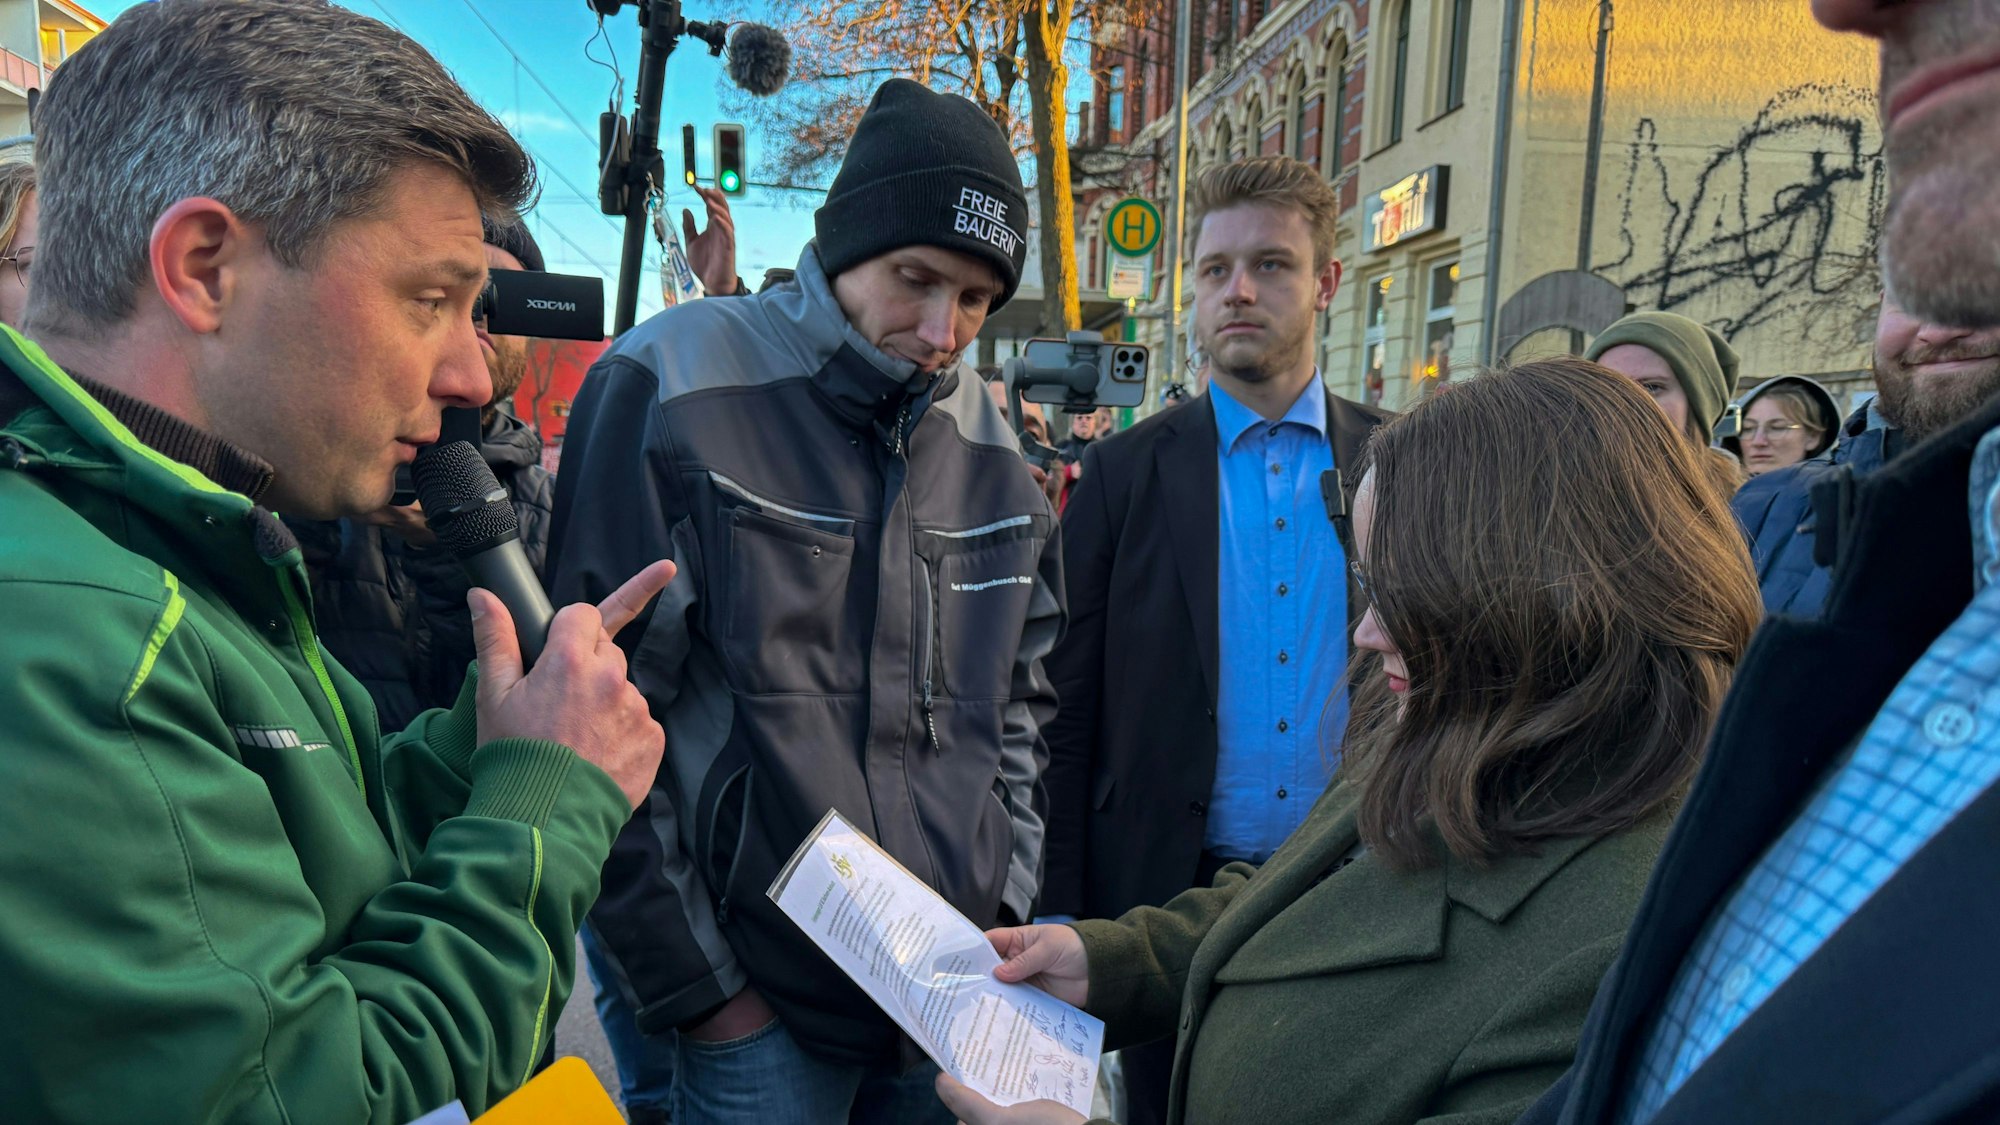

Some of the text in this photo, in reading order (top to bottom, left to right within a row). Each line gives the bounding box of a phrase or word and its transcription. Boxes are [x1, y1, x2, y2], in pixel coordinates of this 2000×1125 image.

[959, 186, 1008, 223] FREIE
[954, 211, 1017, 258] BAUERN
[1122, 210, 1146, 245] H
[526, 298, 576, 312] XDCAM
[961, 576, 1017, 591] Müggenbusch
